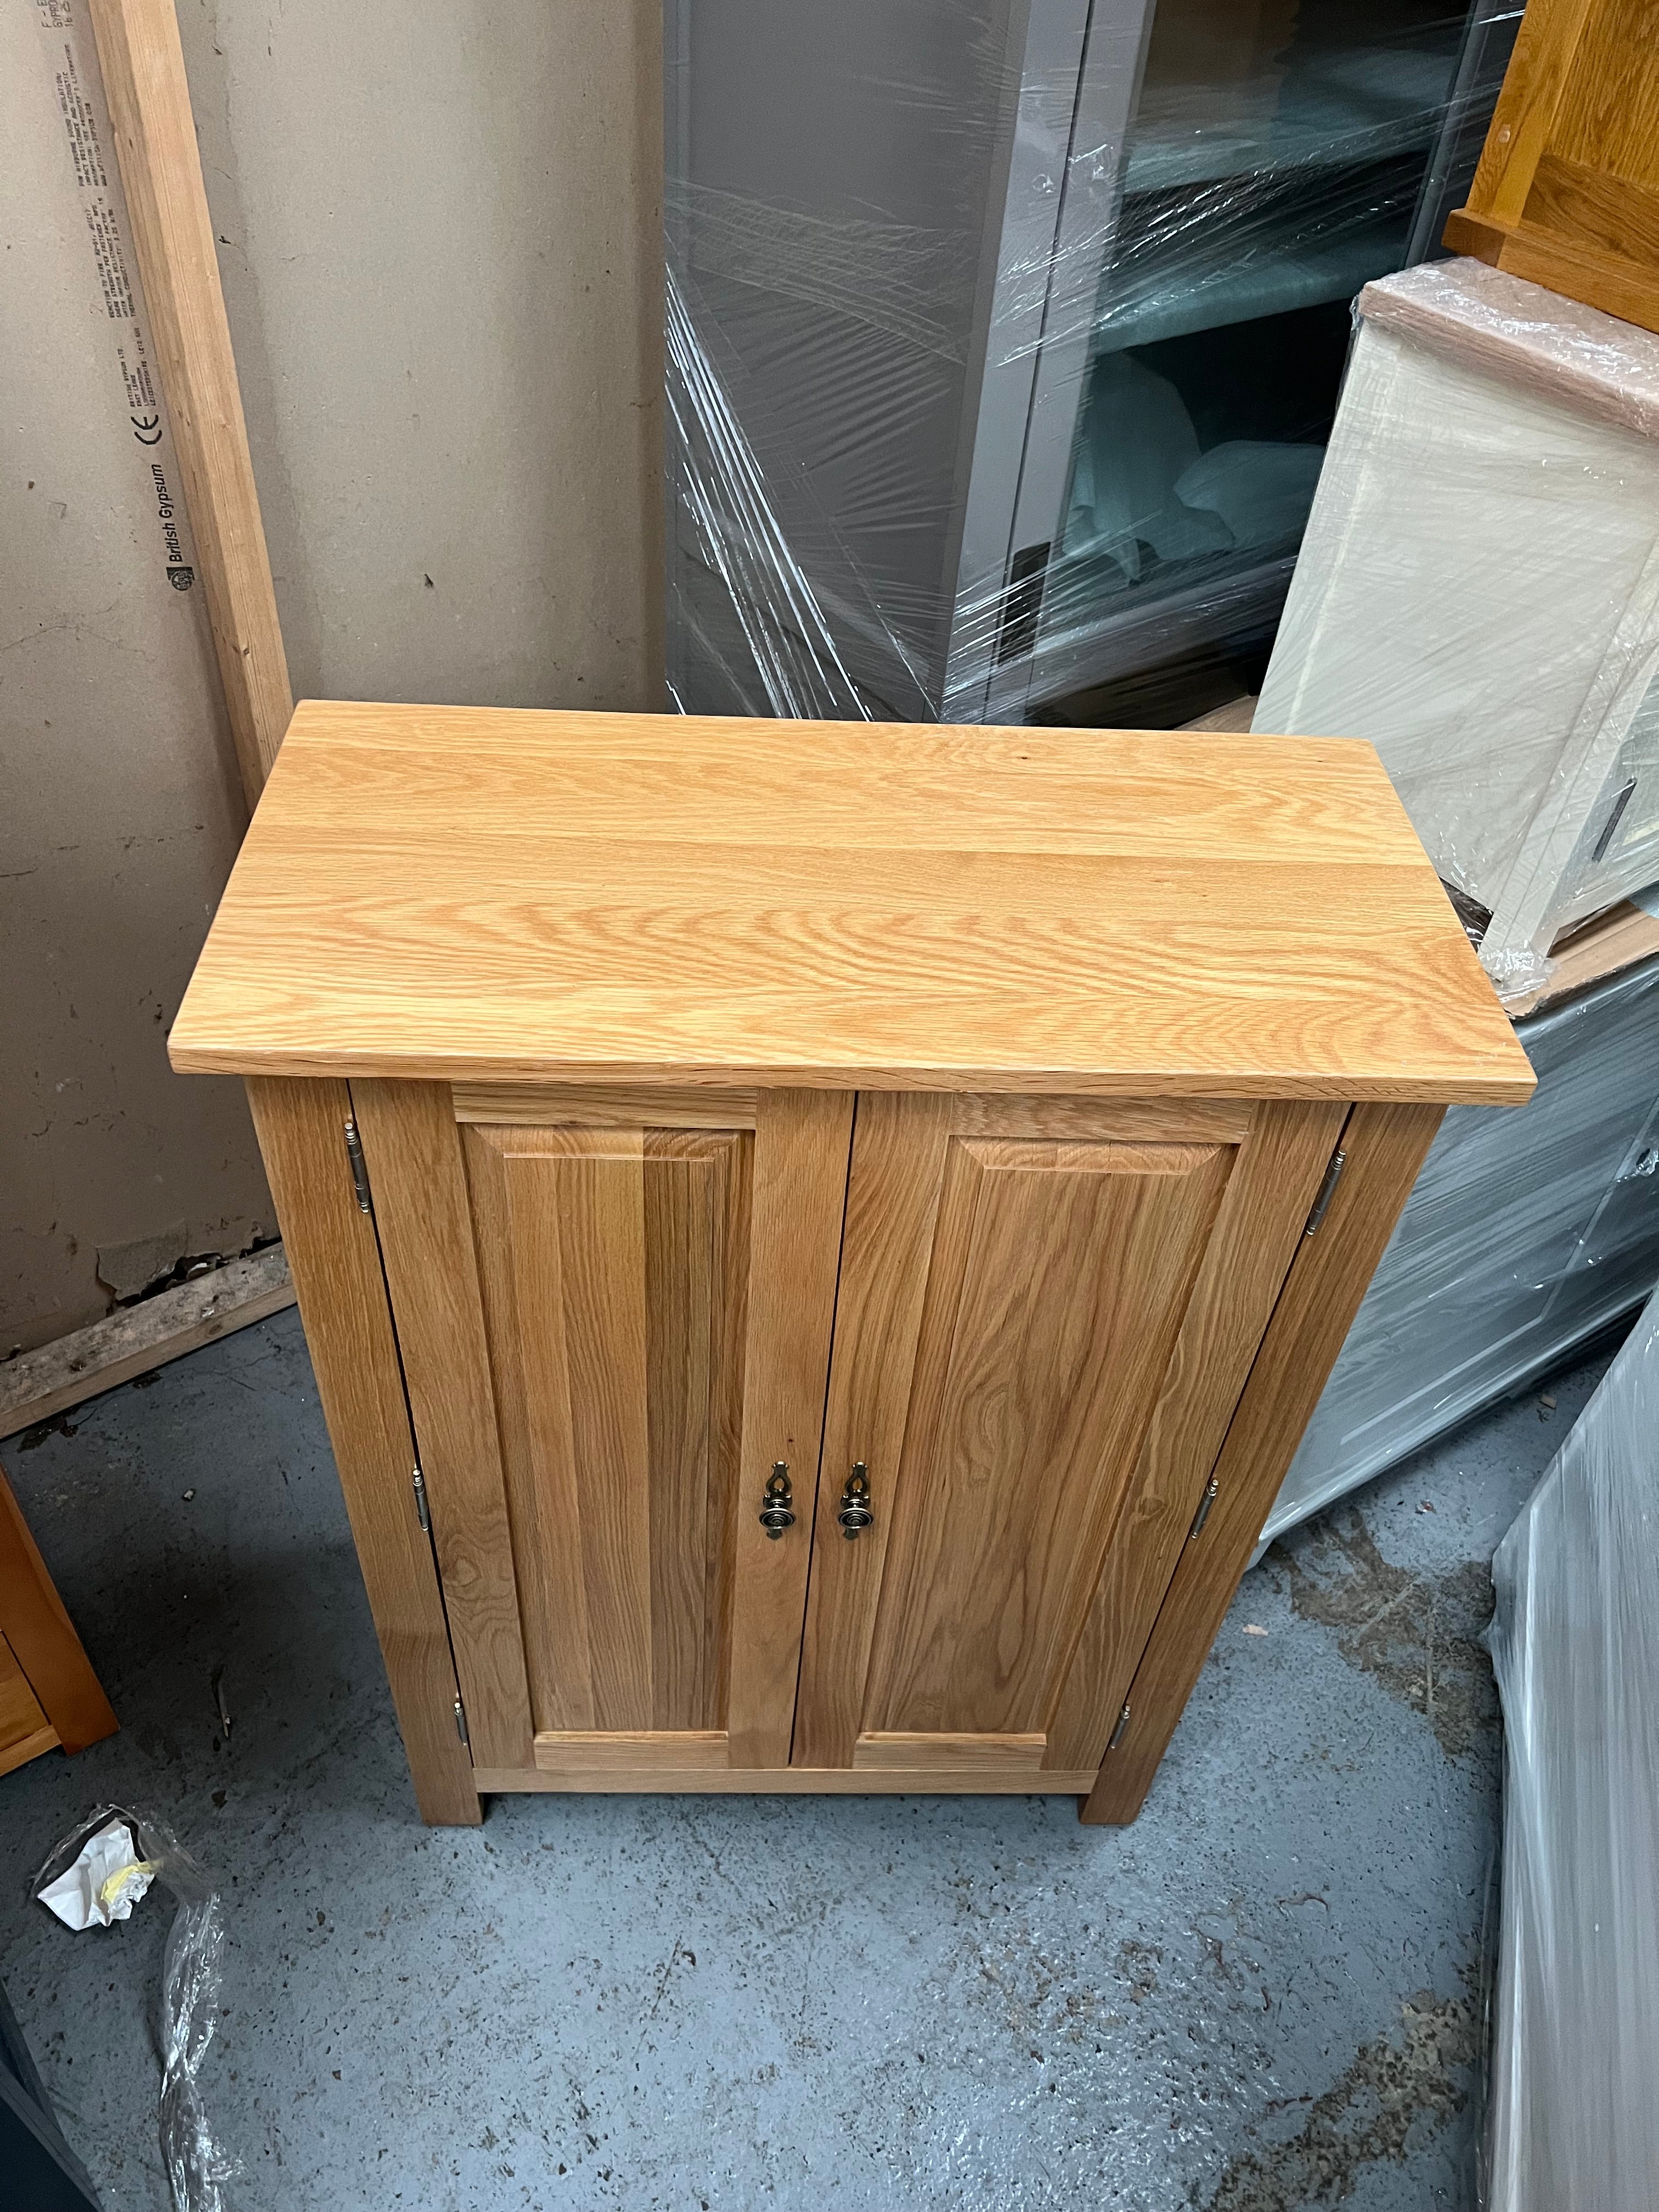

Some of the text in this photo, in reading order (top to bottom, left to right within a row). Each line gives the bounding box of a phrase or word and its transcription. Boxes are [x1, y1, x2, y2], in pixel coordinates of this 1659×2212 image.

[126, 384, 135, 407] BRITISH
[151, 464, 183, 562] British Gypsum
